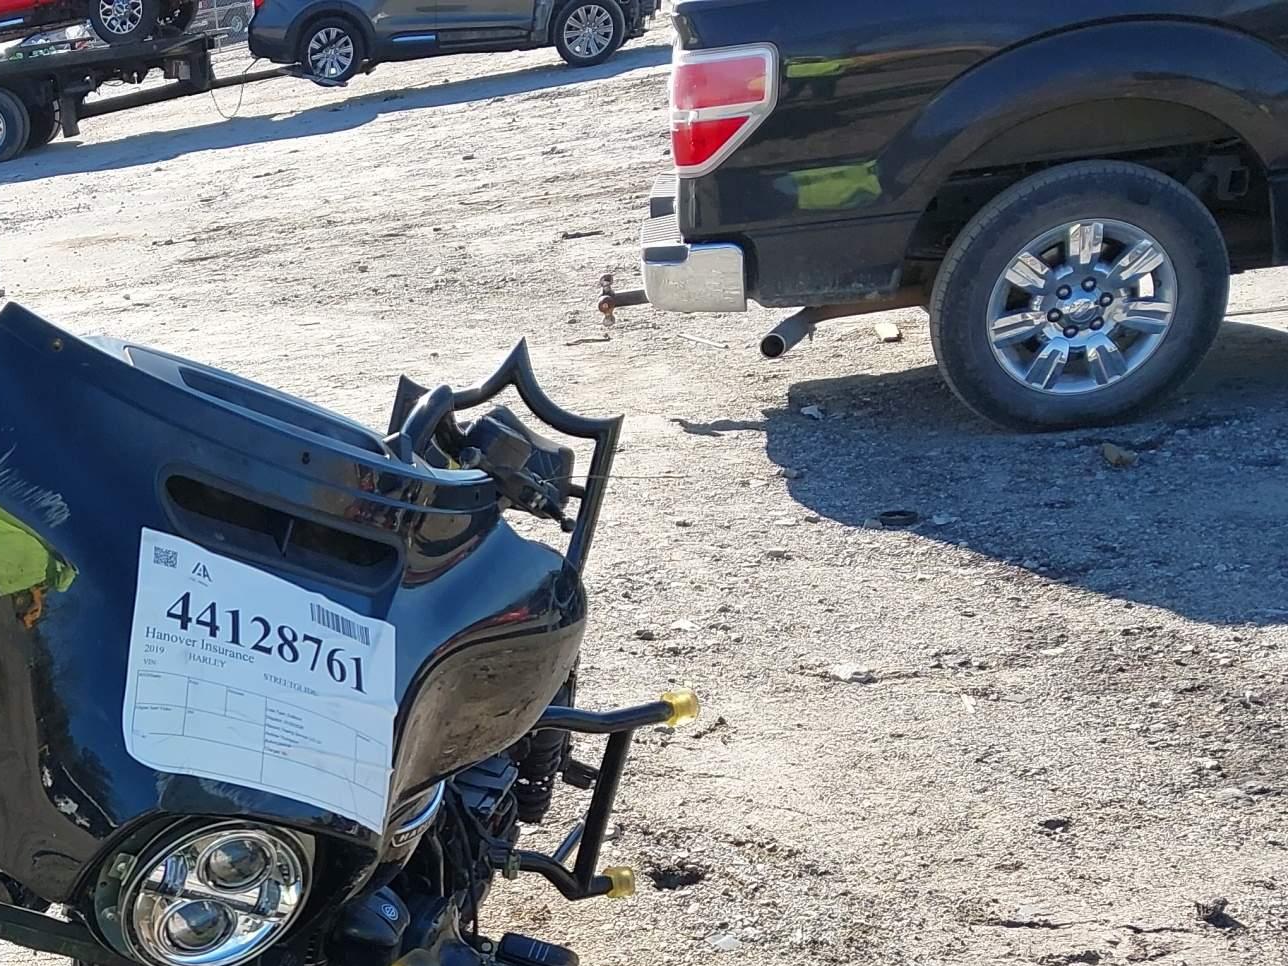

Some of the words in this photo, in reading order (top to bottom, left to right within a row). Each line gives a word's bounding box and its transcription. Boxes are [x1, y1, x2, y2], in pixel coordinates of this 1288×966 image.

[143, 643, 165, 654] 2019
[188, 652, 227, 669] HARLEY
[145, 626, 198, 648] Hanover
[200, 639, 255, 664] Insurance
[165, 591, 368, 696] 44128761
